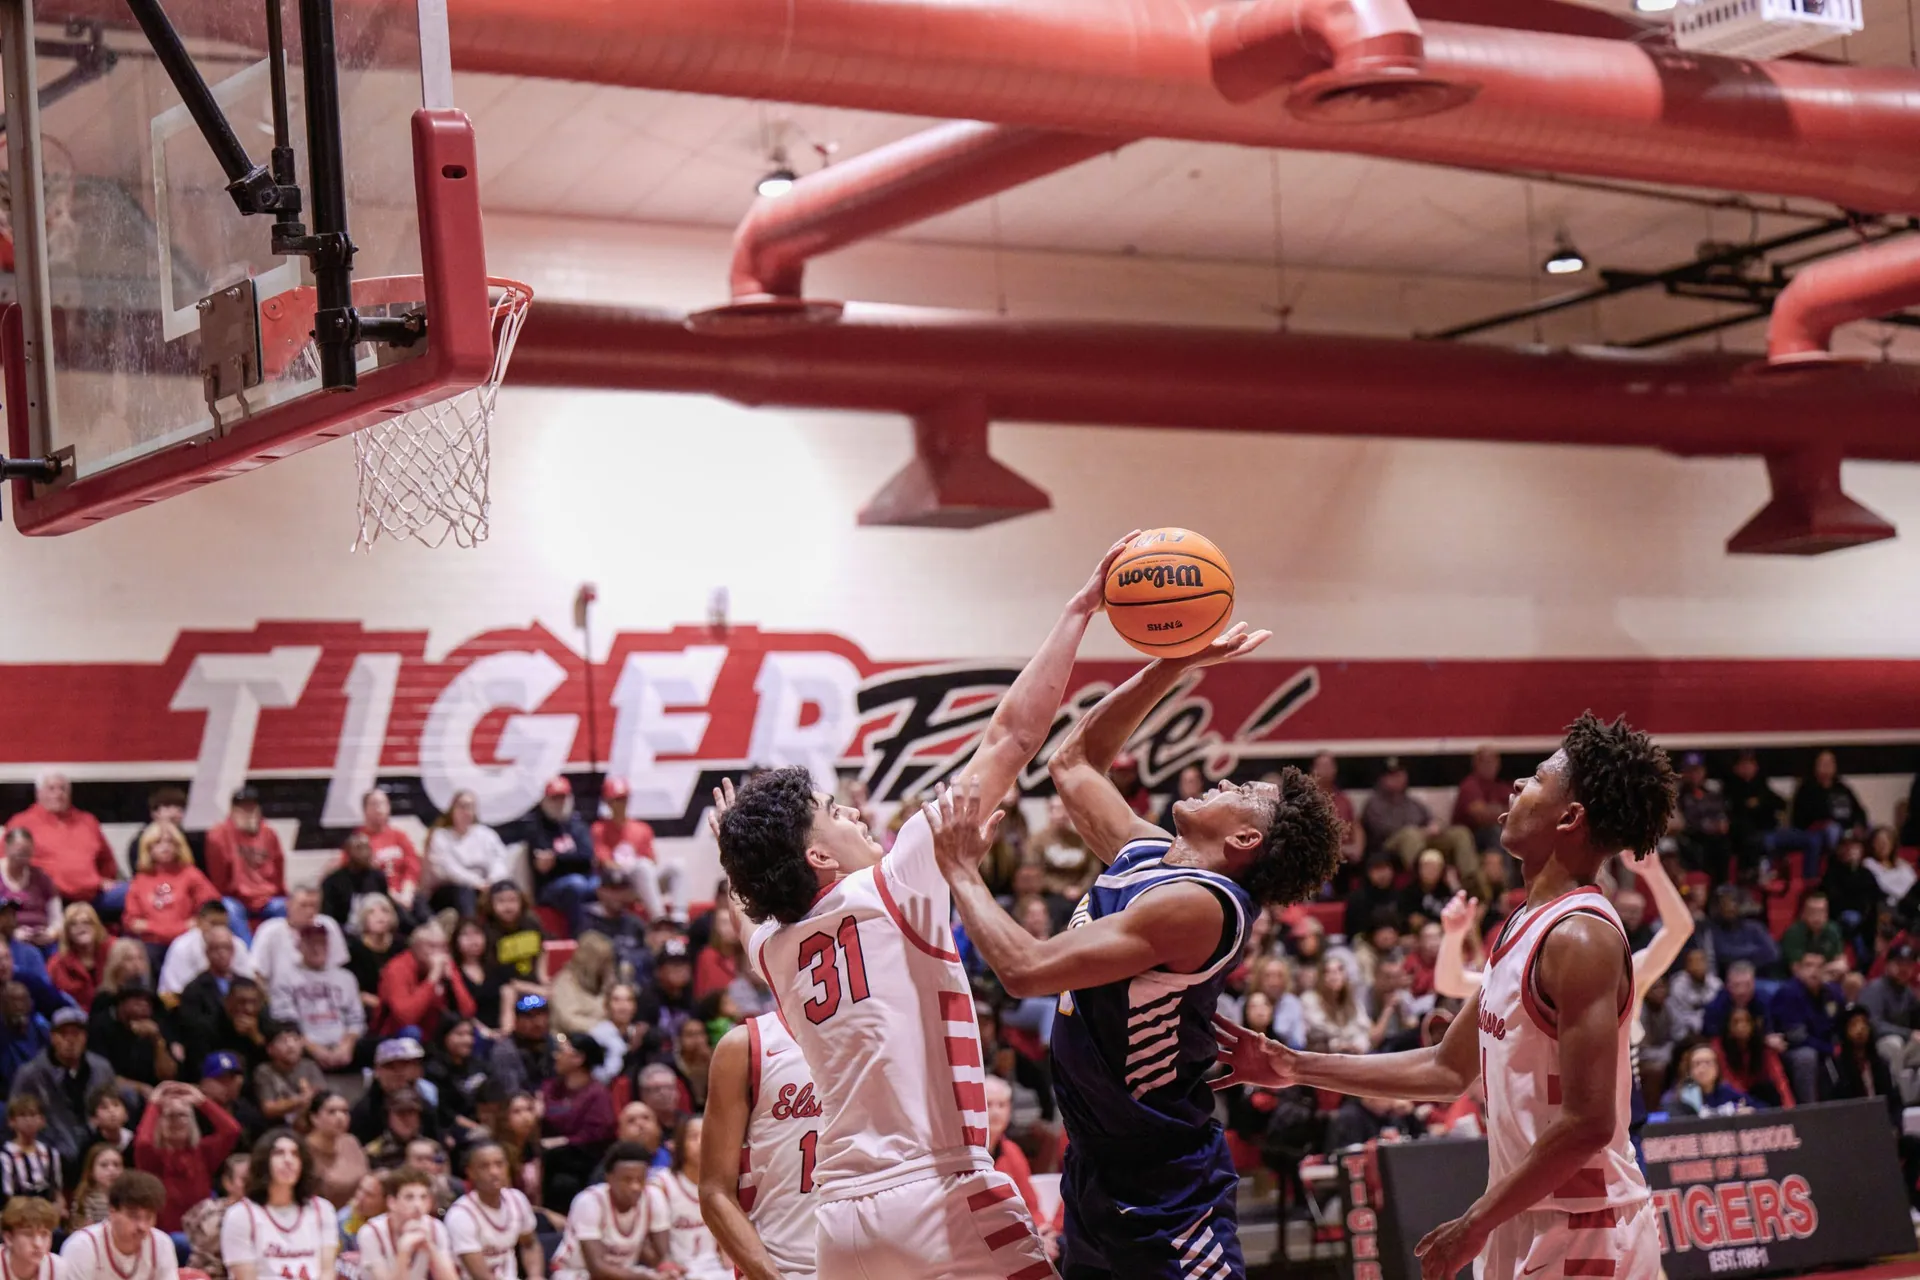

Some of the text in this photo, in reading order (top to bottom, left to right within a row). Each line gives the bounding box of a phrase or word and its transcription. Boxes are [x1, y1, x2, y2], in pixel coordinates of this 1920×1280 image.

[1117, 564, 1203, 588] Wilson
[1147, 620, 1176, 632] NFHS
[169, 645, 862, 830] TIGER
[798, 915, 870, 1025] 31
[1648, 1174, 1819, 1254] TIGERS
